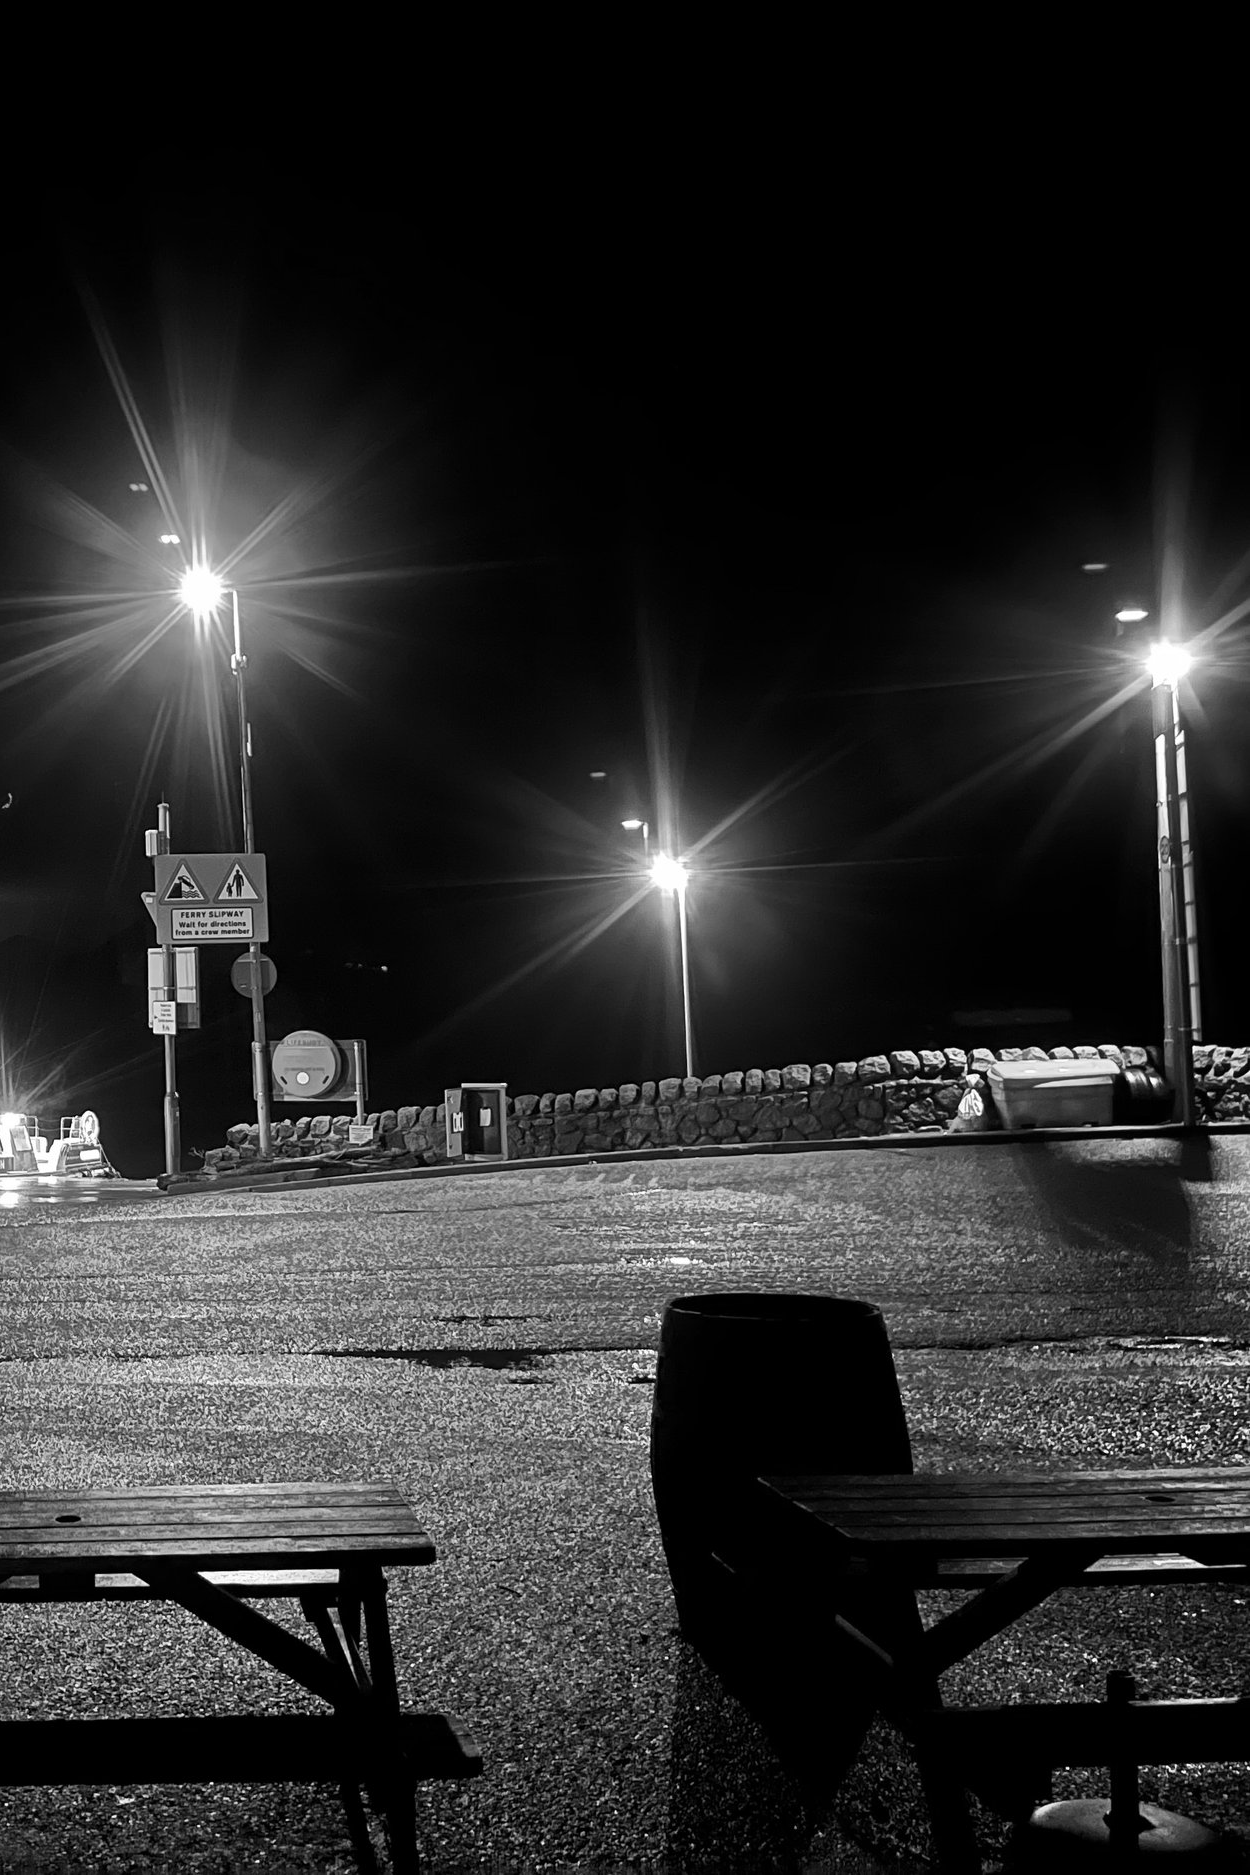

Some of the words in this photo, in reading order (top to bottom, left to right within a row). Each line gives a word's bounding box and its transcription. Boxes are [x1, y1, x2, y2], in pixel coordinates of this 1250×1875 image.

[180, 911, 206, 919] FERRY
[208, 910, 244, 918] SLIPWAY
[210, 920, 247, 928] directions
